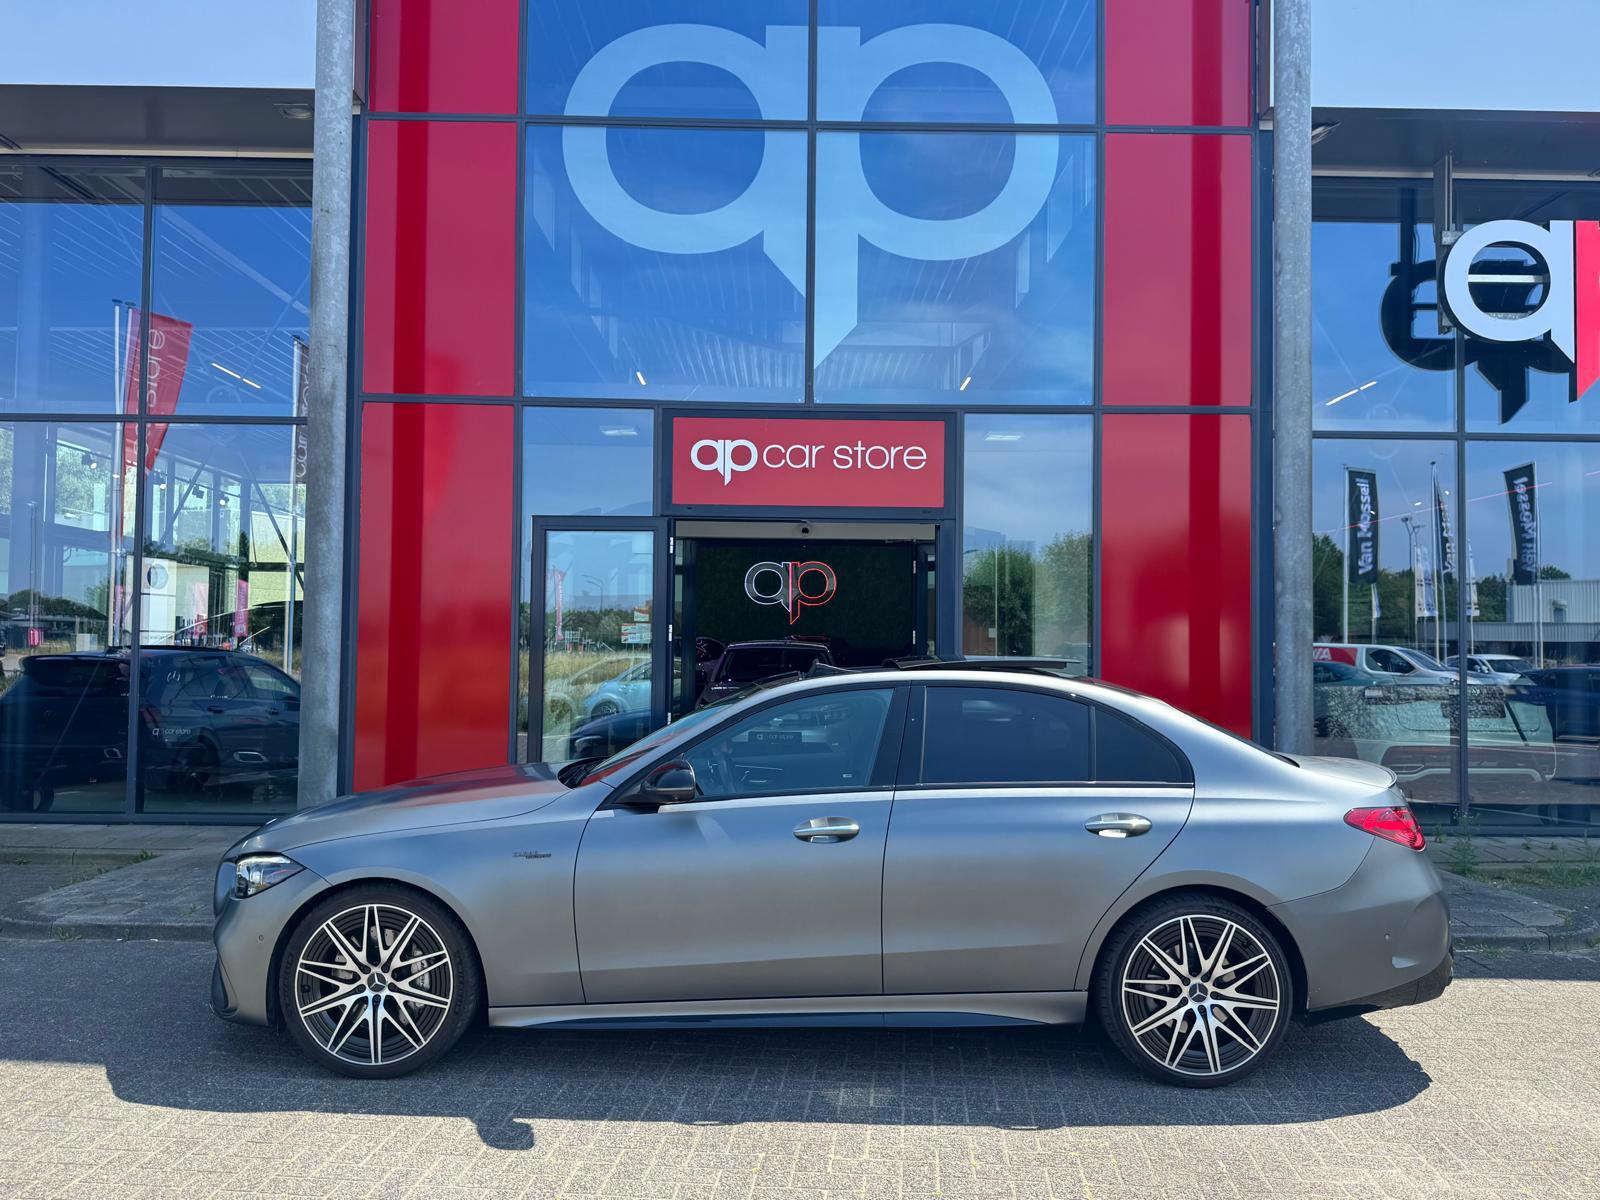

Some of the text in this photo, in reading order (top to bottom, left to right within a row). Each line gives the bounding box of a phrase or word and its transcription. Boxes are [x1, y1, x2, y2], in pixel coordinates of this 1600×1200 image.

[562, 24, 1059, 370] ap
[690, 439, 927, 486] ap car store
[1357, 542, 1374, 575] Van
[744, 560, 837, 625] ap
